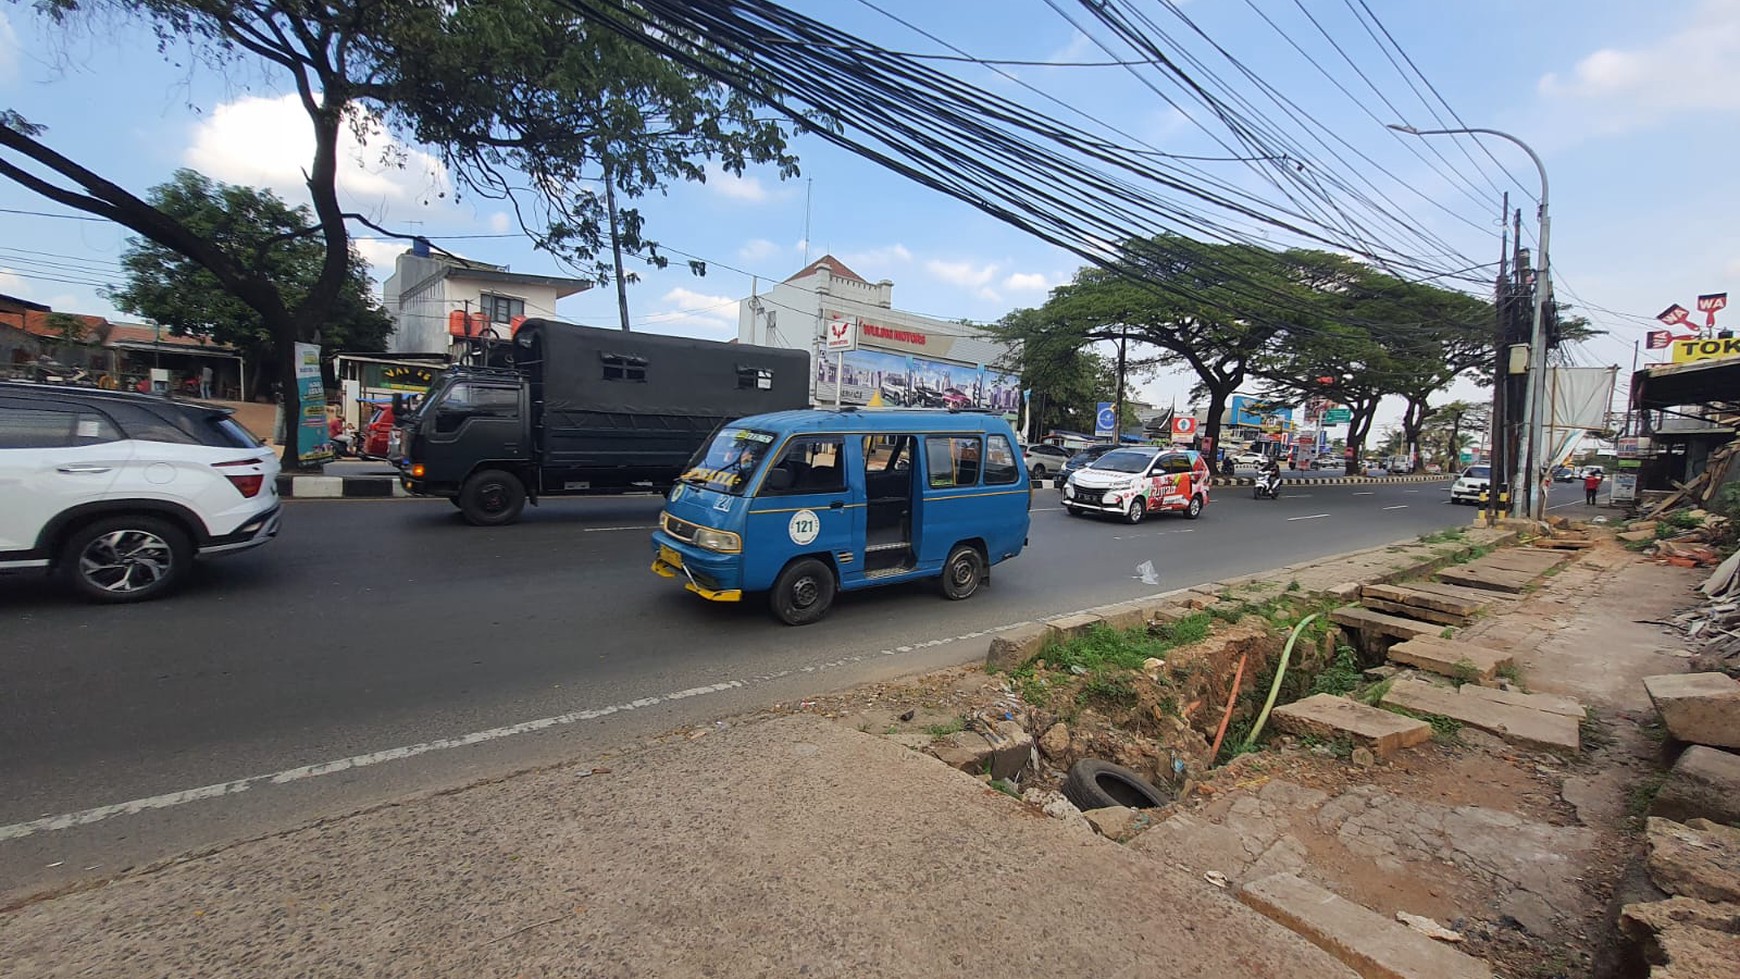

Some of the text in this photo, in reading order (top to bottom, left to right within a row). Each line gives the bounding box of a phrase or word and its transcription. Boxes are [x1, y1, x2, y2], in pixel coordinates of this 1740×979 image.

[1700, 299, 1724, 310] WA
[1661, 308, 1685, 323] WA
[1652, 331, 1668, 348] WA
[1681, 340, 1740, 356] TOK
[796, 520, 813, 533] 121
